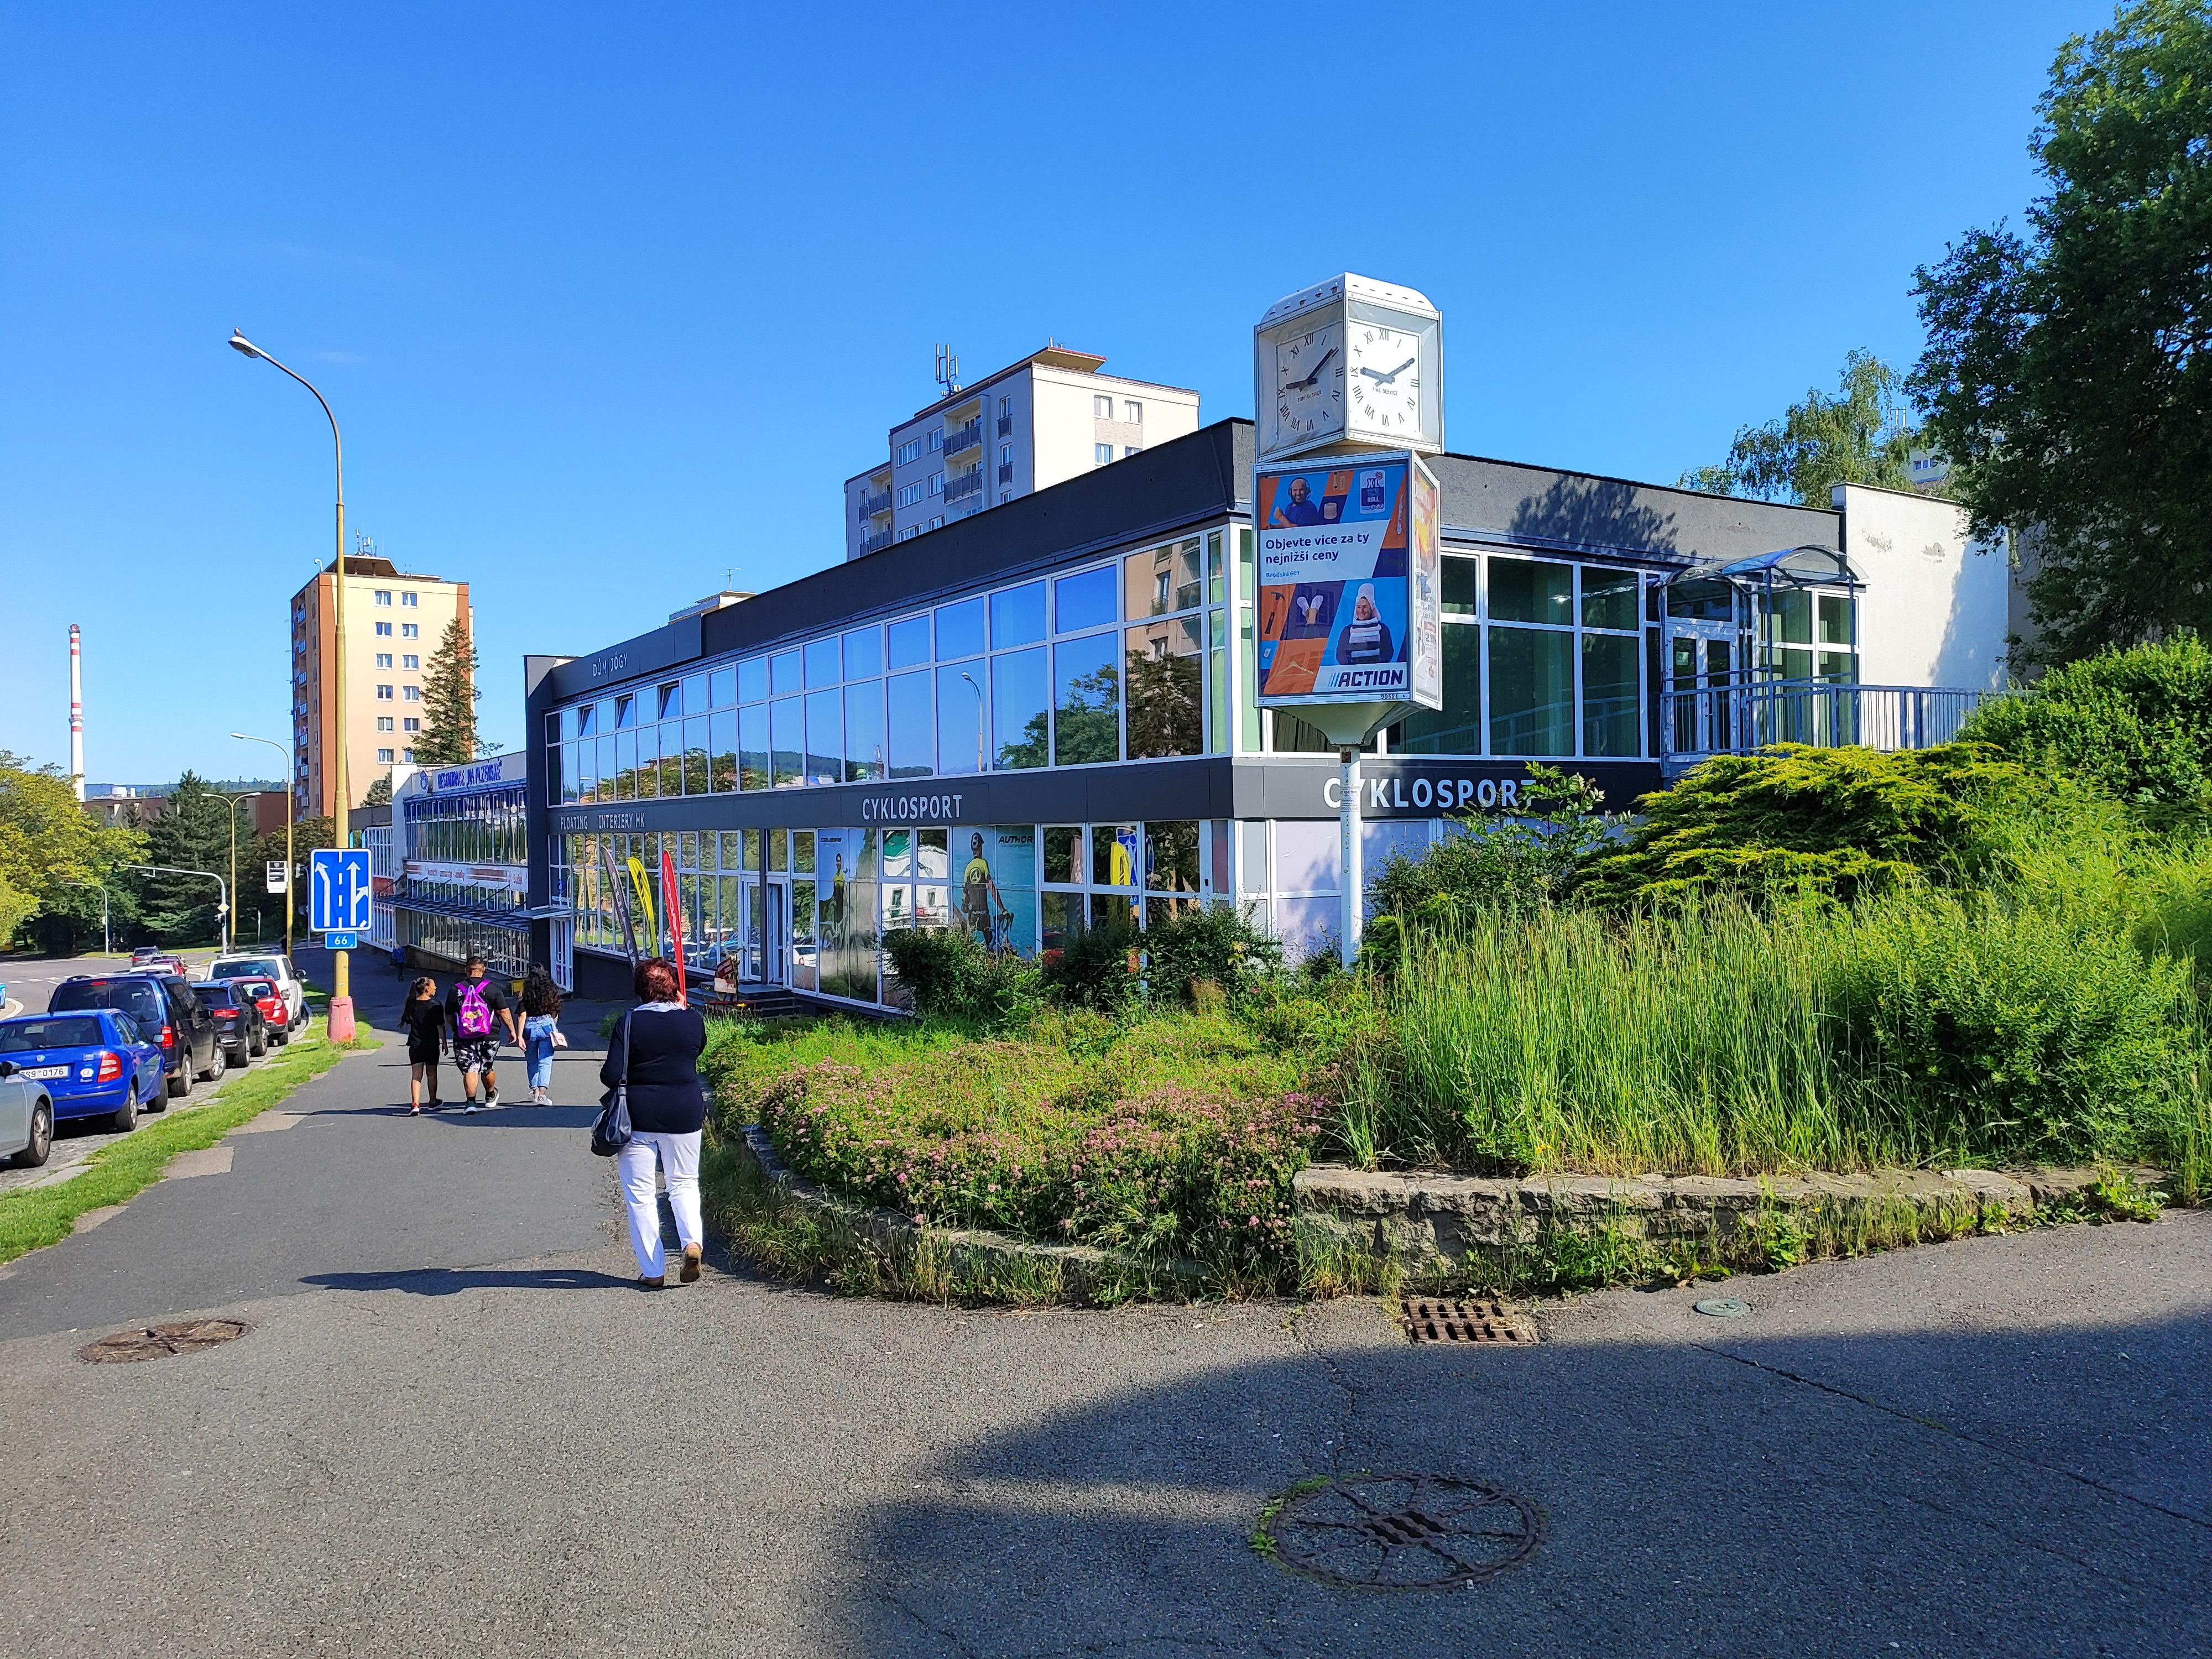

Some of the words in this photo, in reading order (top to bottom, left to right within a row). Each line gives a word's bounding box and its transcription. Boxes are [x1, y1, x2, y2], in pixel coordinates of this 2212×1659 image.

[1266, 538, 1311, 550] Objevte
[1314, 534, 1338, 545] více
[1341, 535, 1353, 544] za
[1357, 533, 1369, 544] ty
[1266, 550, 1309, 565] nejnižší
[1312, 551, 1339, 561] ceny
[593, 658, 607, 677] DŮM
[611, 651, 628, 672] JÓGY
[1338, 669, 1404, 687] ACTION
[862, 795, 962, 820] CYKLOSPORT
[560, 816, 588, 830] FLOATING
[598, 813, 634, 829] INTERIERY
[636, 812, 645, 828] HK
[334, 935, 348, 945] 66
[43, 1068, 64, 1077] 0176
